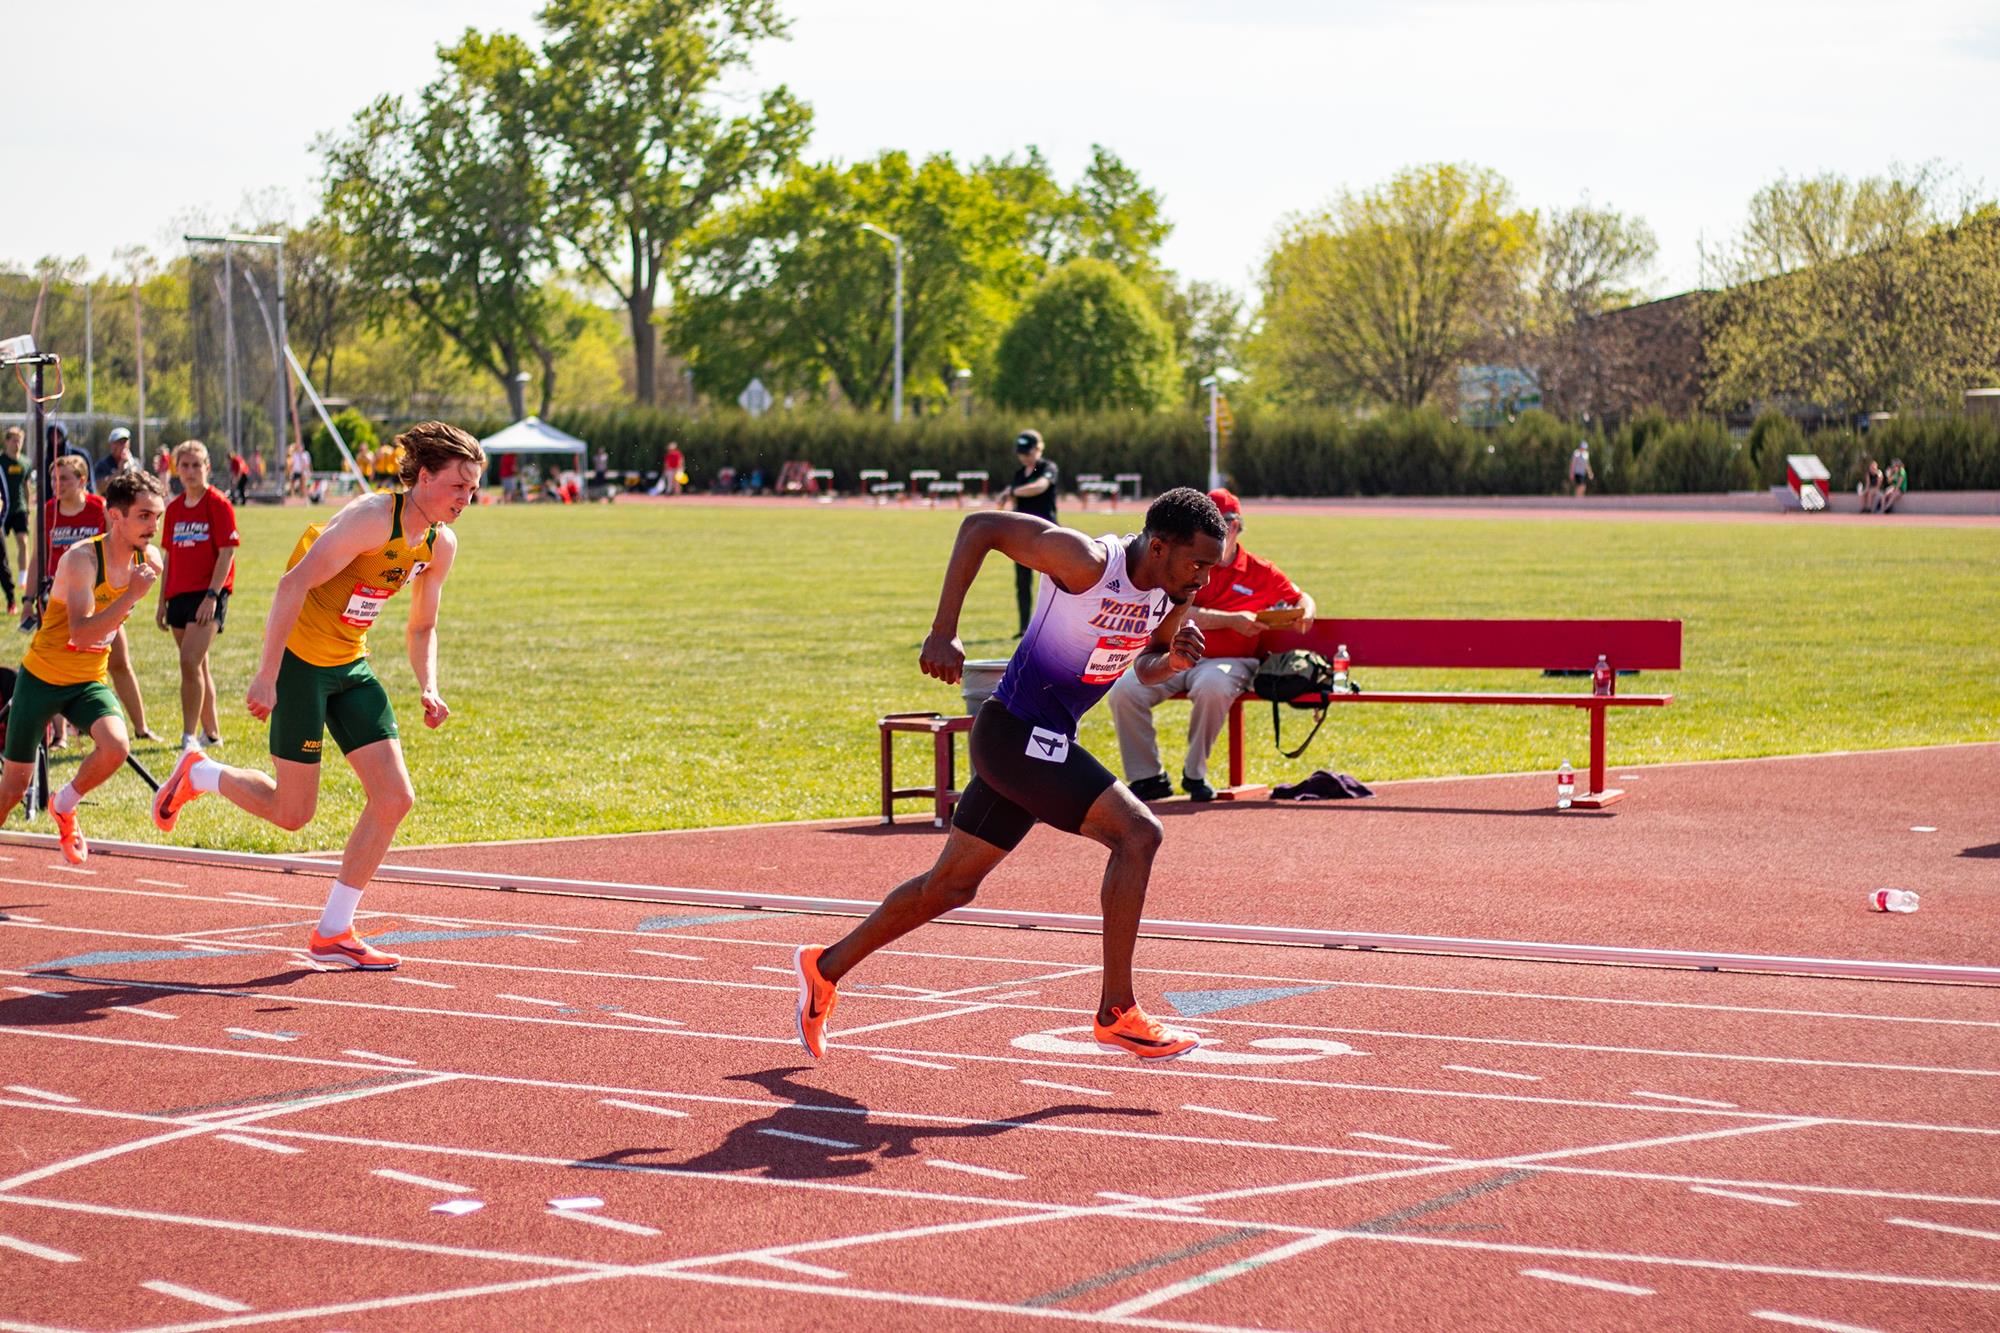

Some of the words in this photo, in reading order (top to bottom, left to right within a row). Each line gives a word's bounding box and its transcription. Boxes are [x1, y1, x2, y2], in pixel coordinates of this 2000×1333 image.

[1152, 592, 1170, 623] 4
[1088, 613, 1153, 635] ILLINO
[303, 740, 322, 749] NDS
[1031, 734, 1064, 757] 4
